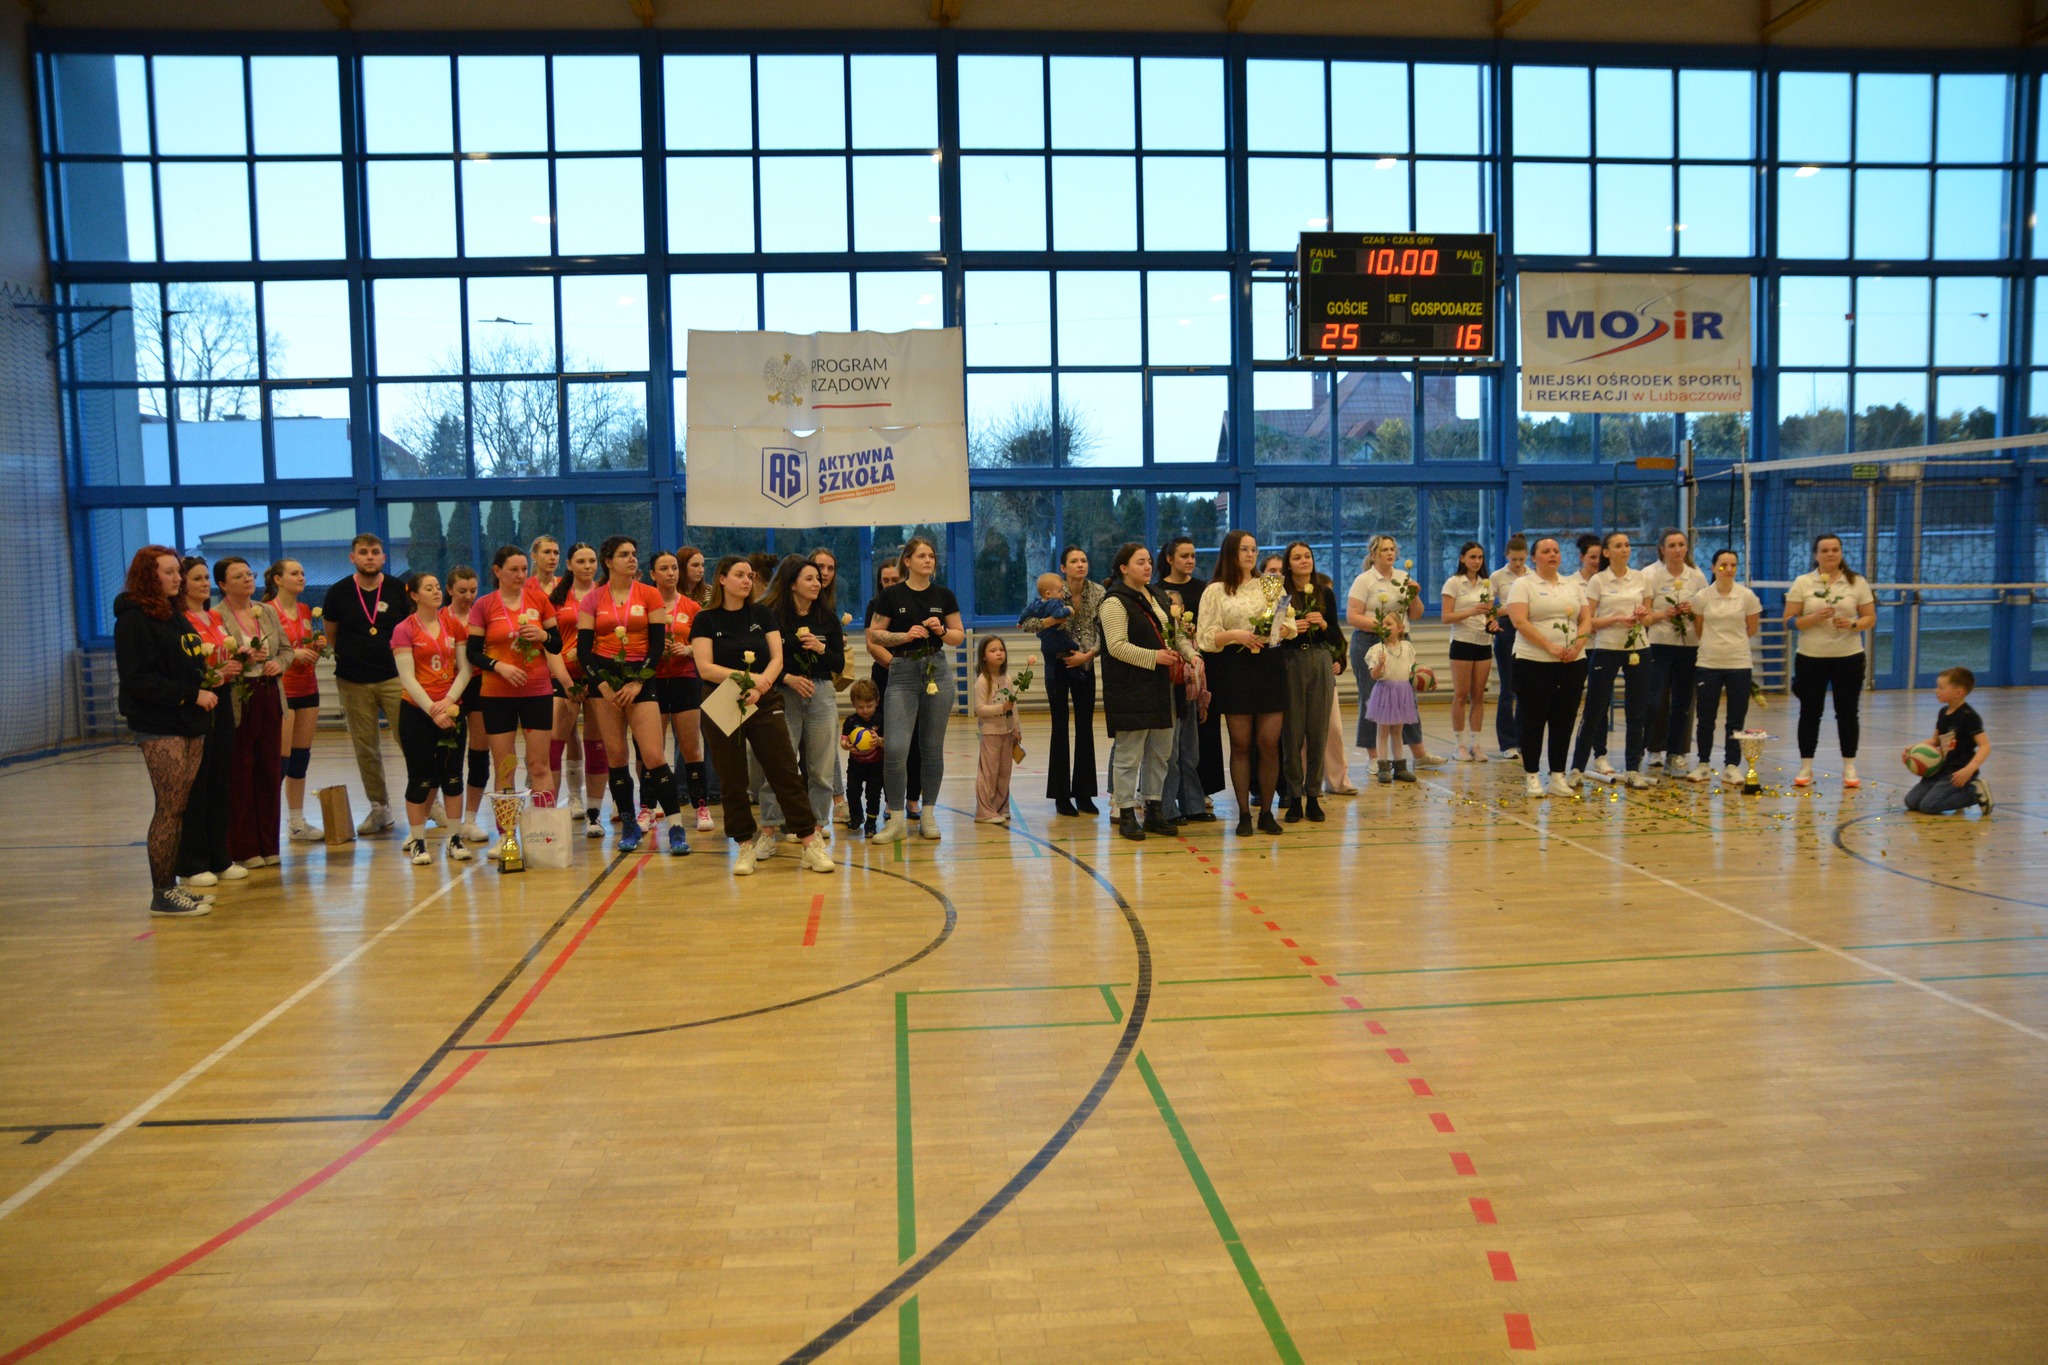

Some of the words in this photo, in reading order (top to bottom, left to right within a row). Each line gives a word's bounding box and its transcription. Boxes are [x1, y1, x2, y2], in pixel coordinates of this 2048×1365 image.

[1362, 236, 1386, 245] CZAS
[1392, 236, 1415, 246] CZAS
[1416, 237, 1435, 246] GRY
[1310, 249, 1337, 258] FAUL
[1456, 250, 1483, 260] FAUL
[1311, 258, 1322, 274] 0
[1472, 260, 1484, 275] 0
[1388, 294, 1408, 303] SET
[1327, 299, 1369, 315] GOŚCIE
[1411, 302, 1483, 316] GOSPODARZE
[1321, 323, 1360, 350] 25
[1455, 324, 1483, 350] 16
[811, 357, 888, 373] PROGRAM
[811, 376, 891, 394] RZĄDOWY
[1528, 374, 1592, 386] MIEJSKI
[1597, 371, 1673, 386] OŚRODEK
[1529, 390, 1533, 400] i
[1537, 389, 1628, 401] REKREACJI
[1632, 391, 1645, 401] w
[1650, 389, 1742, 401] Lubaczowie
[818, 446, 894, 473] AKTYWNA
[769, 453, 801, 499] AS
[818, 463, 895, 494] SZKOŁA
[431, 654, 442, 672] 6
